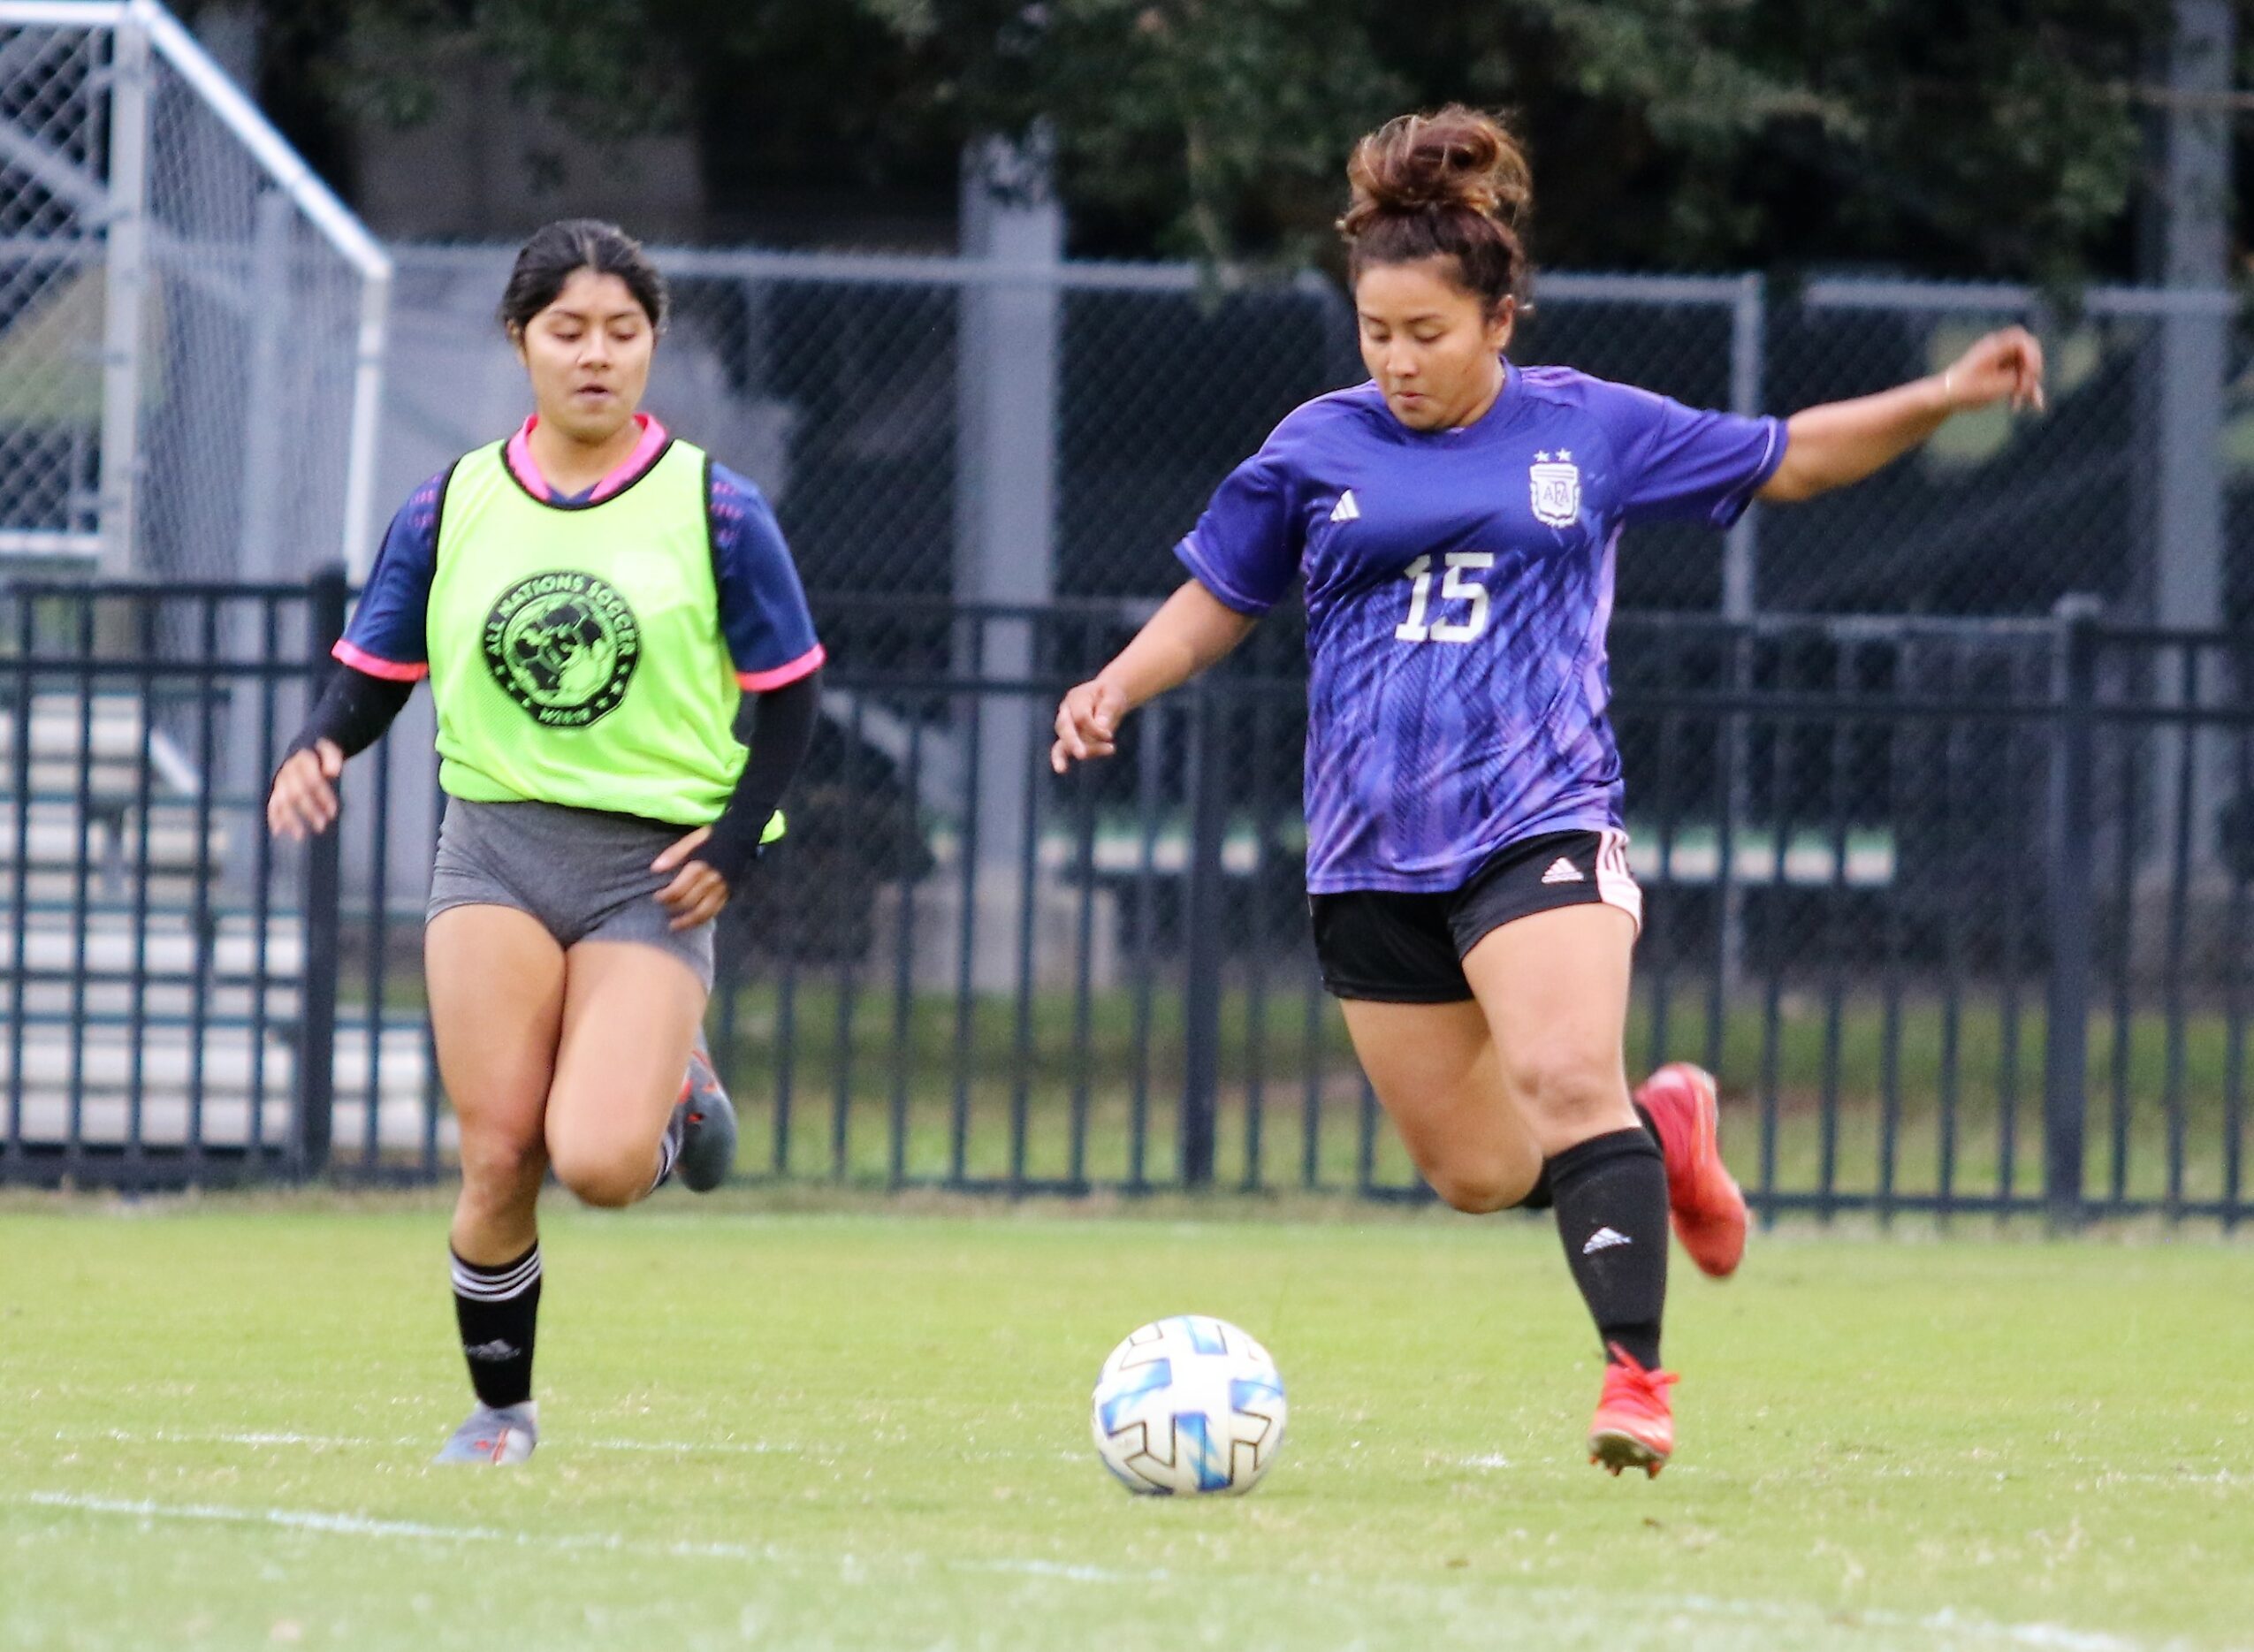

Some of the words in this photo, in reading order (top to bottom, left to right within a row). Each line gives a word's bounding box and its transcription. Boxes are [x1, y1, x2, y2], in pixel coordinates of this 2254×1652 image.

[487, 621, 506, 656] ALL
[498, 575, 584, 618] NATIONS
[588, 581, 637, 657] SOCCER
[1394, 552, 1494, 643] 15
